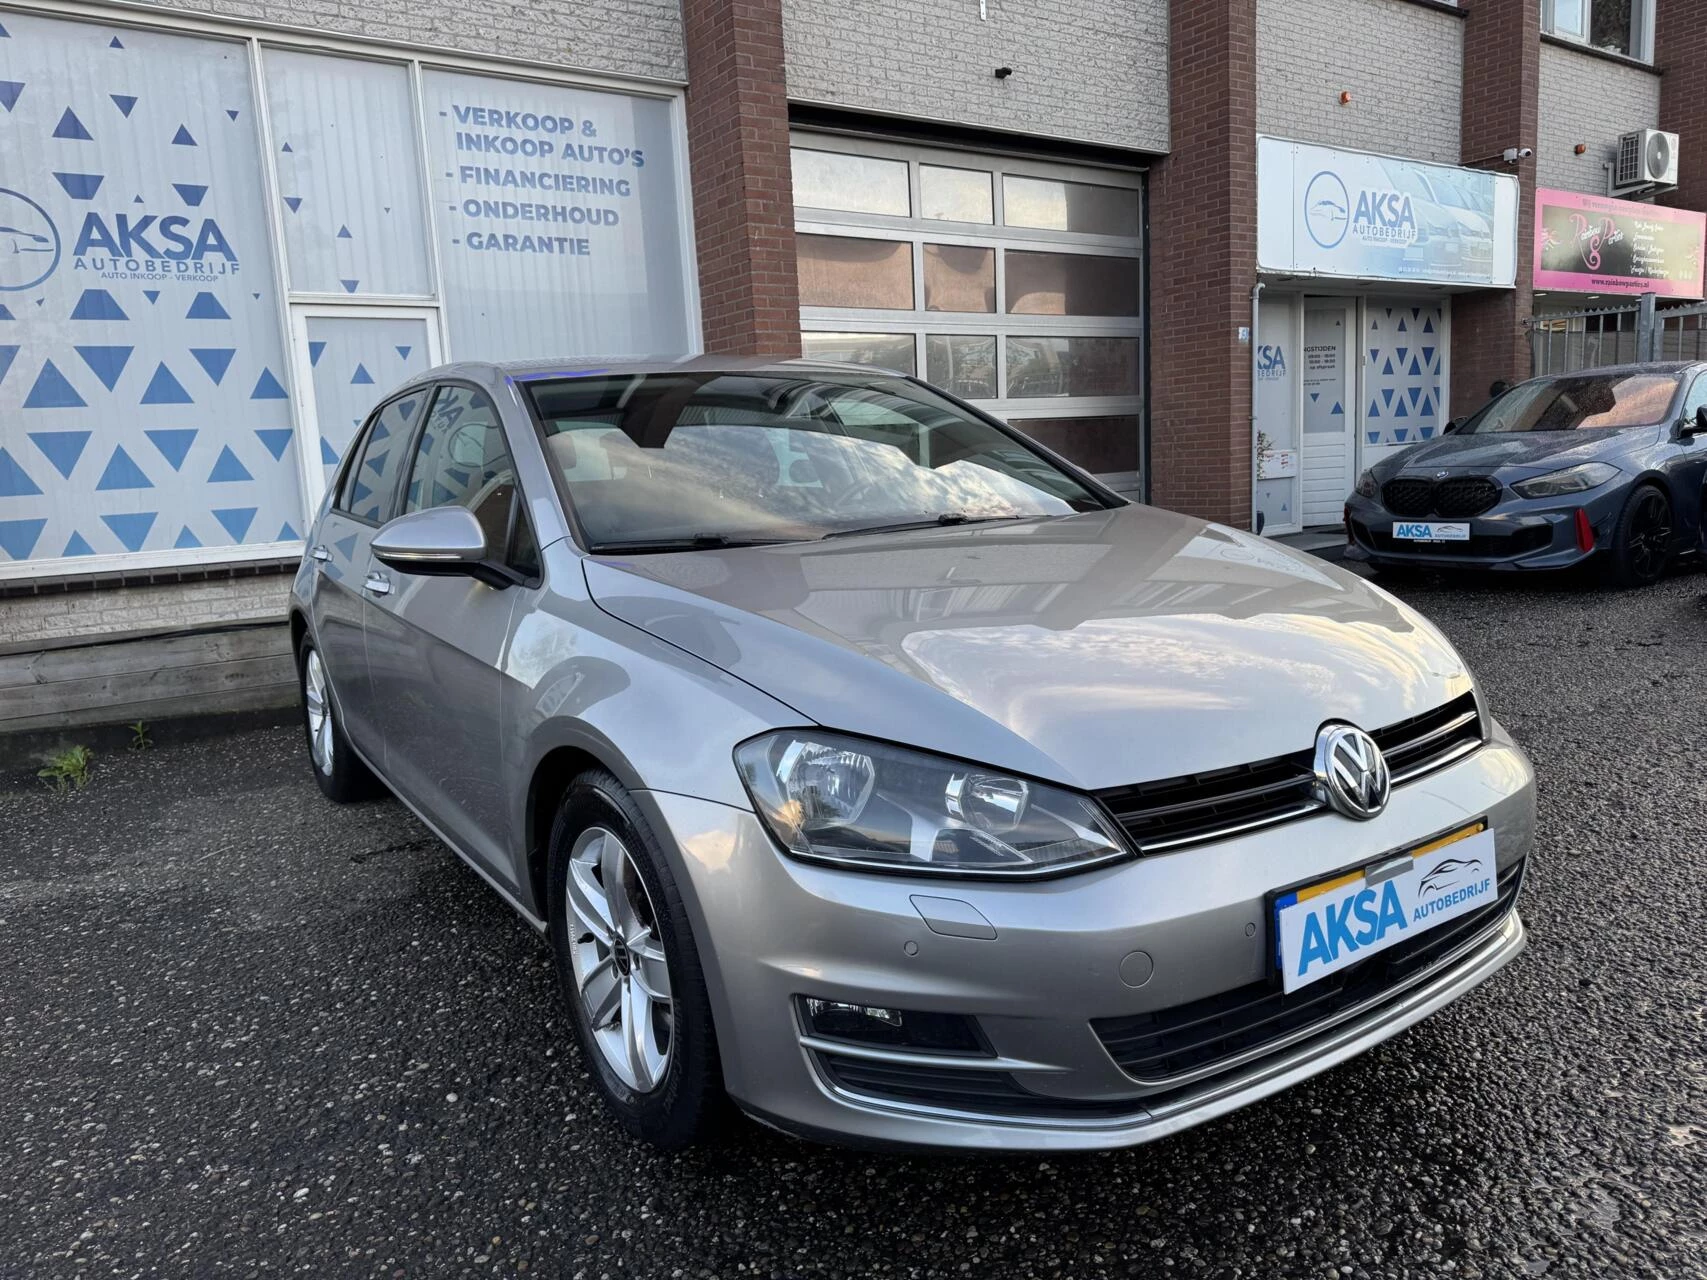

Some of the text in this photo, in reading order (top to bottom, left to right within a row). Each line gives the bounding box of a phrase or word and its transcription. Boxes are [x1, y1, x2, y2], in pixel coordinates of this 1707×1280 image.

[452, 105, 574, 134] VERKOOP
[581, 120, 597, 137] &
[456, 132, 645, 168] INKOOP AUTO'S
[460, 165, 630, 197] FINANCIERING
[463, 199, 619, 226] ONDERHOUD
[1353, 190, 1416, 229] AKSA
[73, 211, 238, 262] AKSA
[466, 232, 590, 256] GARANTIE
[1352, 223, 1416, 239] AUTOBEDRIJF
[73, 257, 240, 275] AUTOBEDRIJF
[101, 272, 127, 280] AUTO
[129, 273, 168, 281] INKOOP
[175, 274, 219, 283] VERKOOP
[1396, 523, 1433, 538] AKSA
[1412, 877, 1491, 923] AUTOBEDRIJF
[1298, 879, 1408, 977] AKSA
